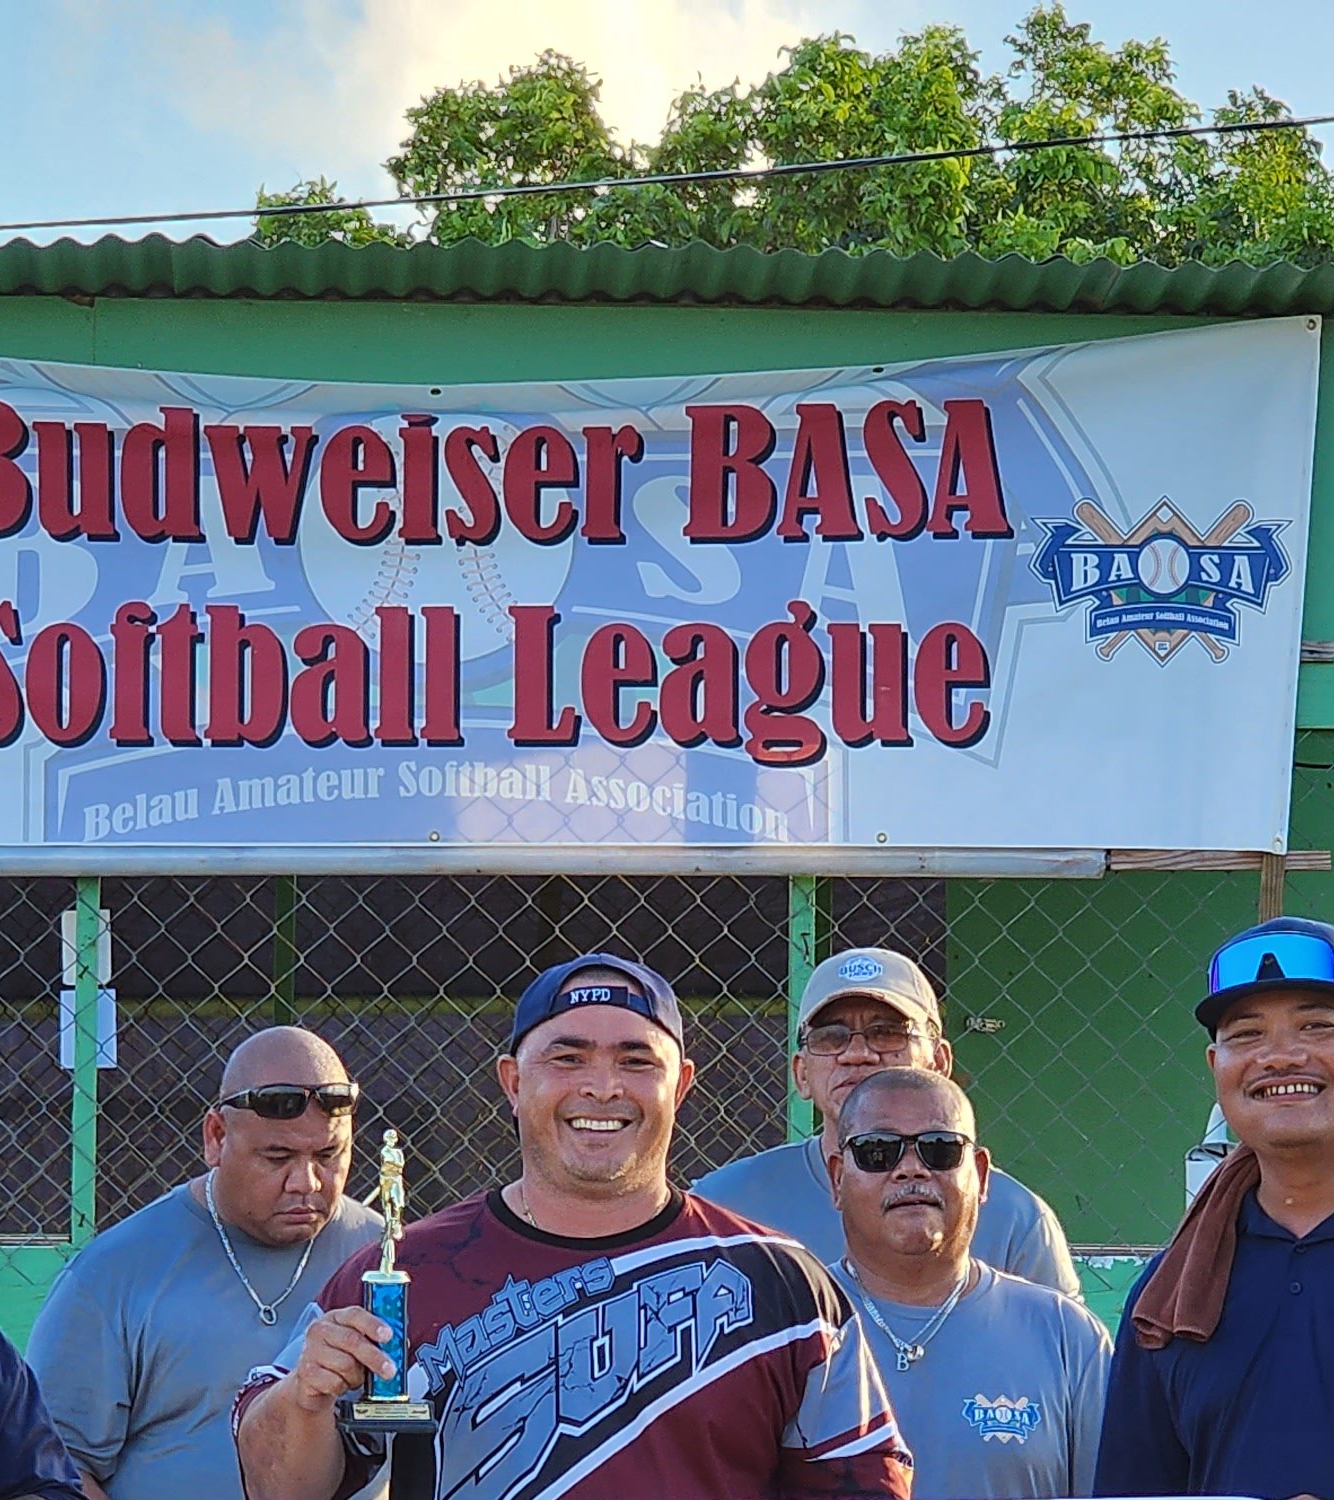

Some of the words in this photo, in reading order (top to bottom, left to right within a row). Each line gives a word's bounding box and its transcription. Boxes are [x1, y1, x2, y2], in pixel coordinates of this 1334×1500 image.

[683, 398, 1015, 545] BASA
[1186, 612, 1229, 631] Association
[508, 600, 992, 768] League
[83, 787, 199, 842] Belau
[212, 766, 384, 815] Amateur
[398, 759, 551, 803] Softball
[564, 767, 789, 842] Association
[570, 988, 611, 1004] NYPD
[416, 1256, 614, 1397] Masters
